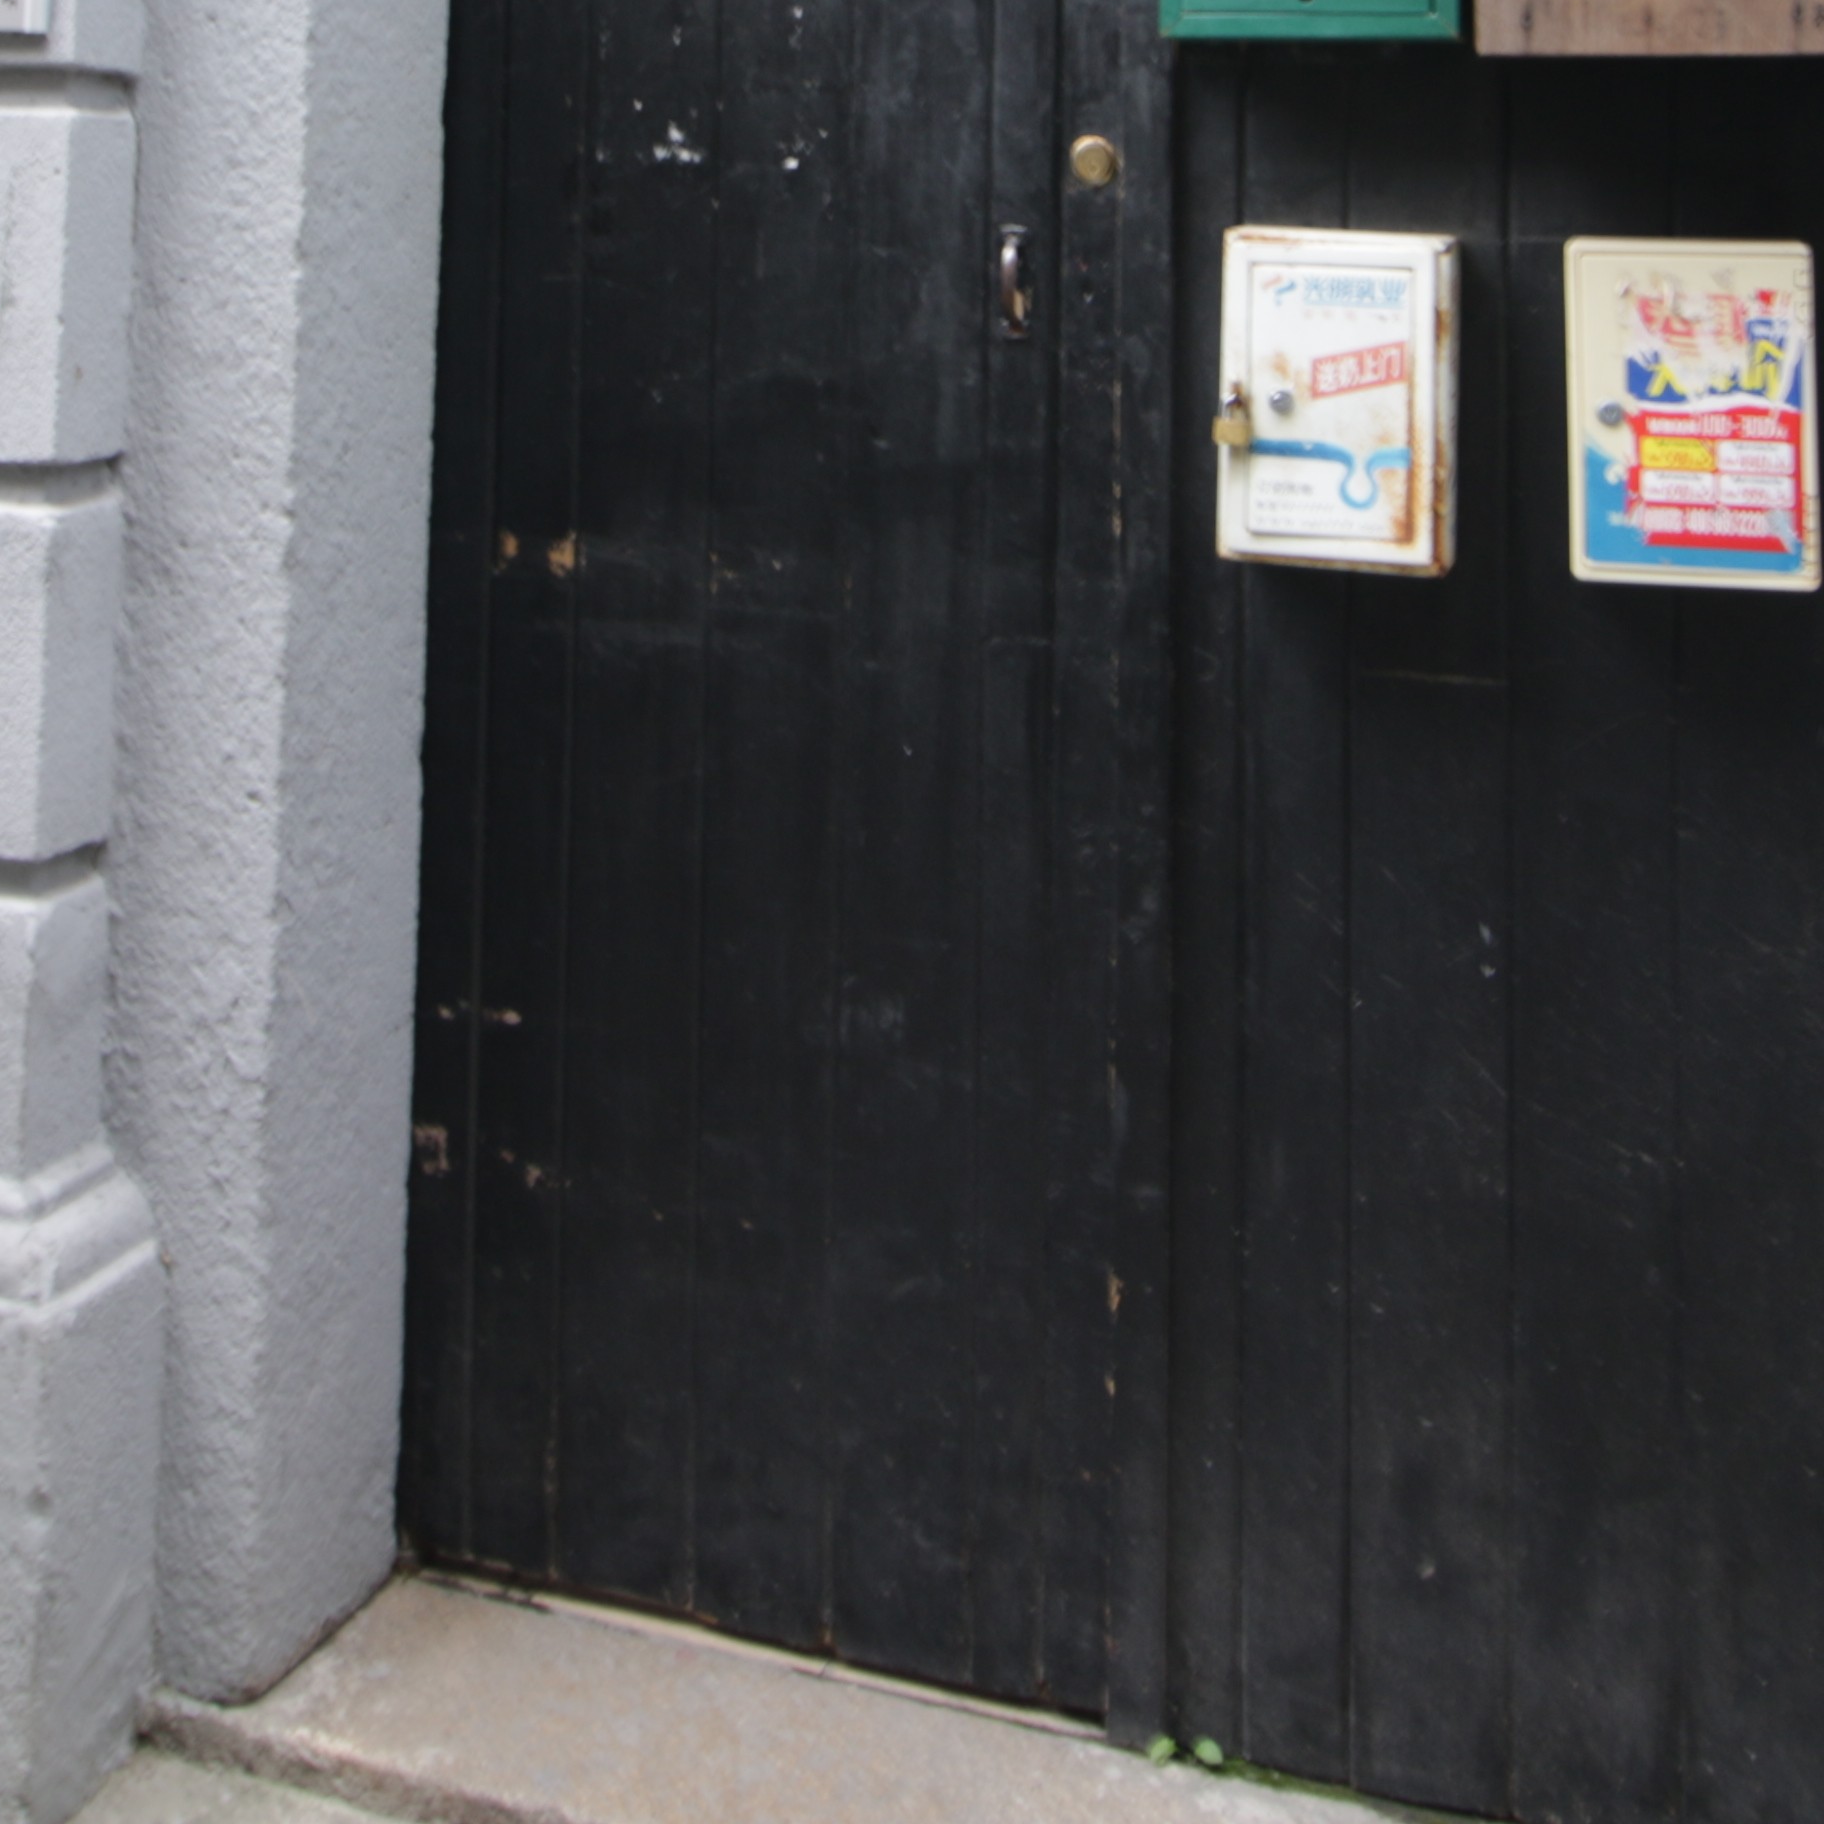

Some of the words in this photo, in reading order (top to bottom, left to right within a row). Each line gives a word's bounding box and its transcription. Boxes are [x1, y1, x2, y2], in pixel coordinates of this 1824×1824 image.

[1302, 275, 1407, 304] 光明乳业
[1316, 345, 1403, 392] 送奶上门
